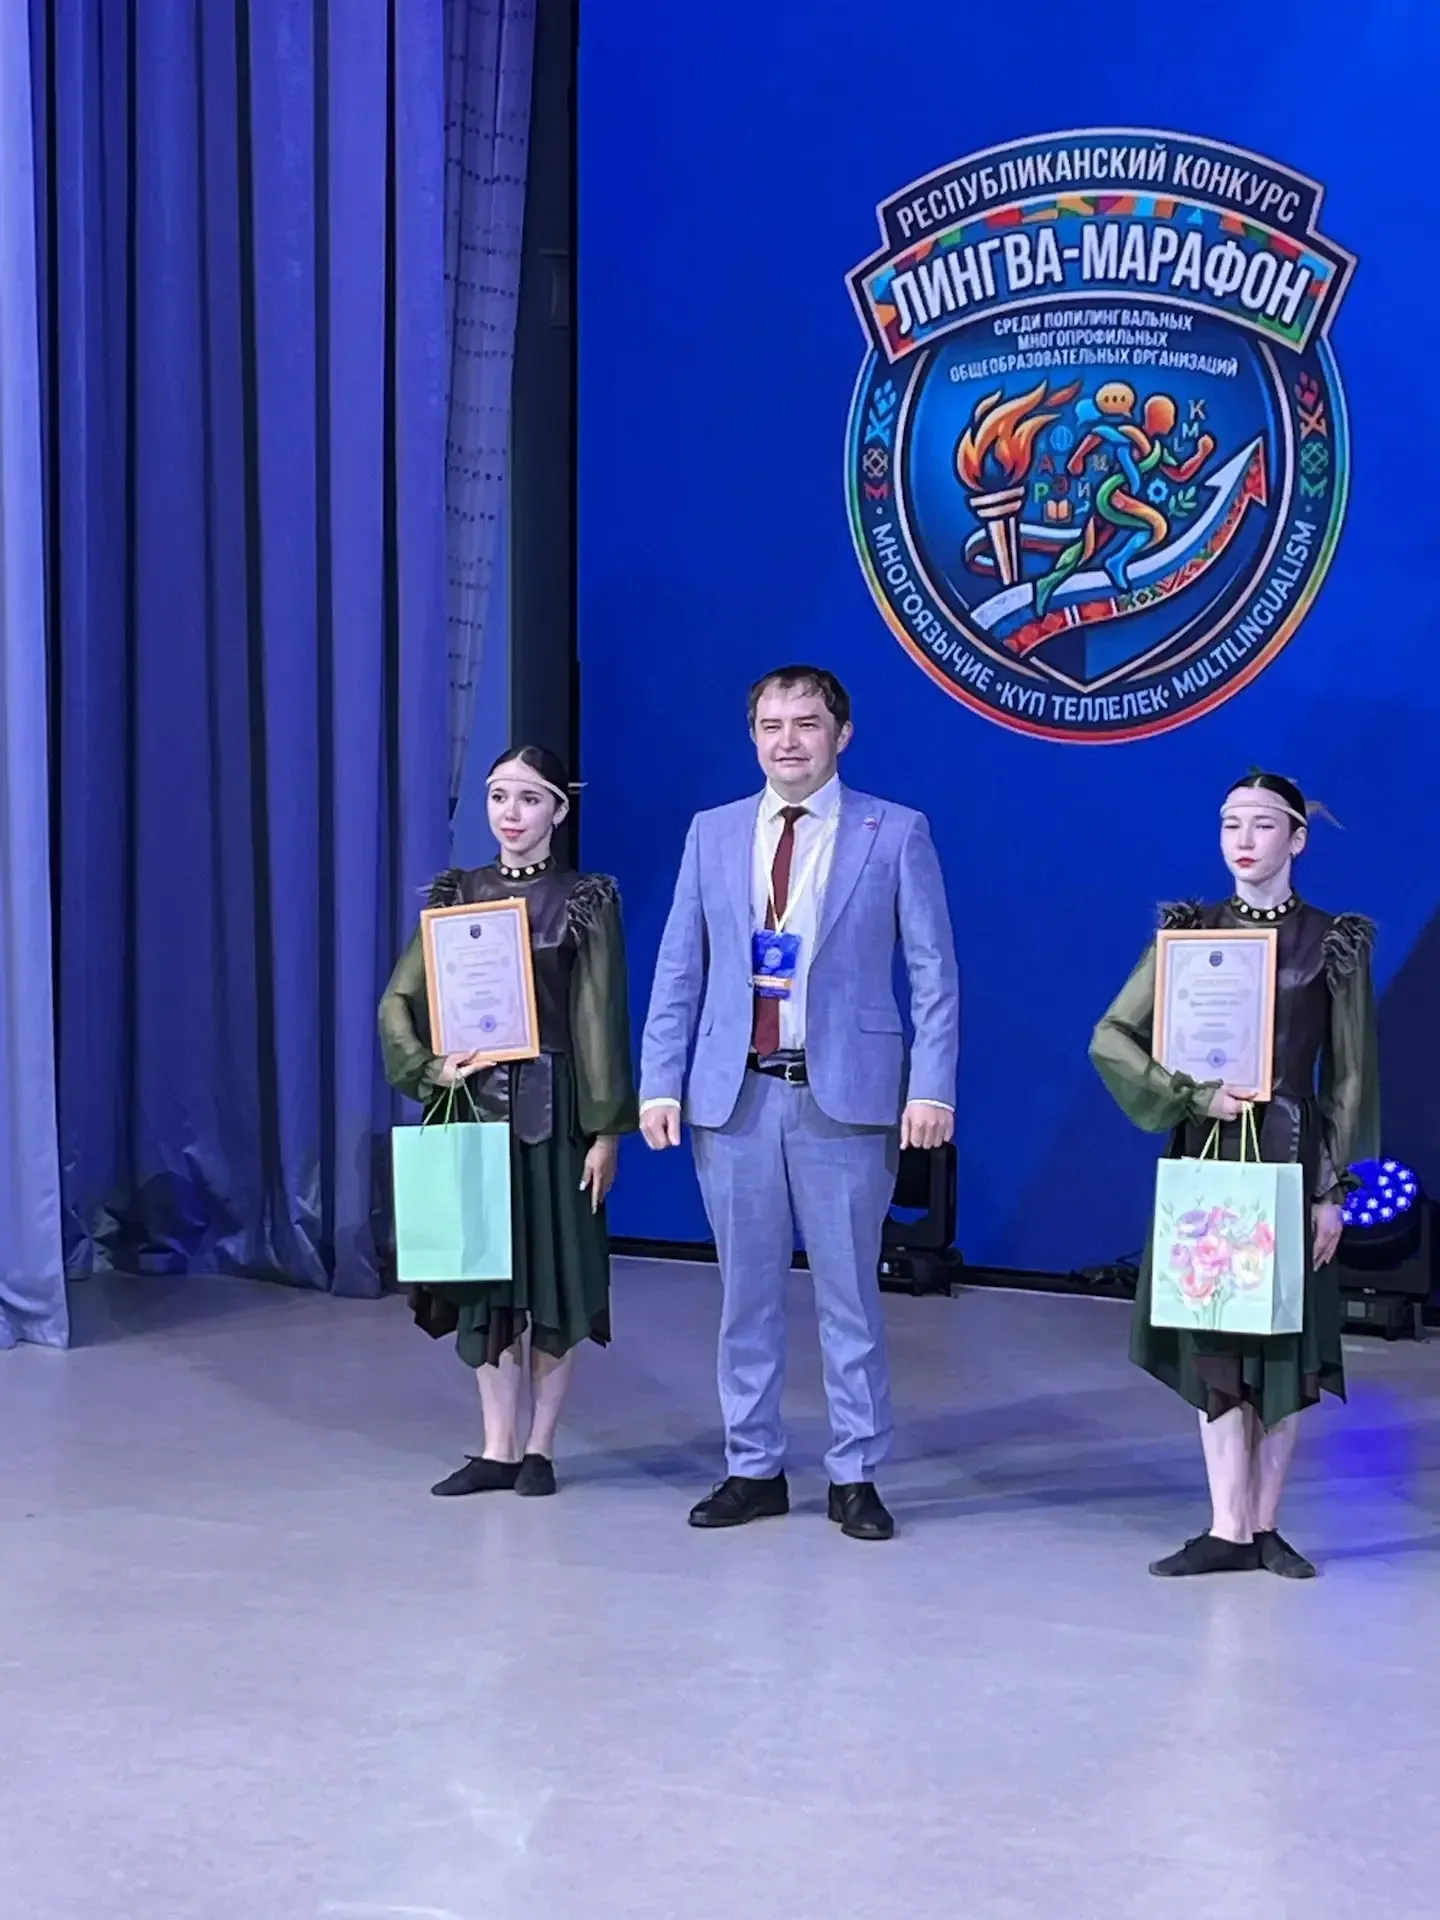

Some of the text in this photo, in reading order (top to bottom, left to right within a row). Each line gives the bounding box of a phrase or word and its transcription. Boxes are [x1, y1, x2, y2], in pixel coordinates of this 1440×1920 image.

[896, 143, 1301, 238] РЕСПУБЛИКАНСКИЙ КОНКУРС
[890, 223, 1310, 335] ЛИНГВА-МАРАФОН
[993, 312, 1041, 336] СРЕДИ
[950, 348, 1239, 383] ОБЩЕОБРАЗОВАТЕЛЬНЫХ ОРГАНИЗАЦИЙ
[1018, 328, 1168, 350] МНОГОПРОФИЛЬНЫХ
[872, 522, 995, 693] МНОГОЯЗЫЧИЕ
[1171, 519, 1317, 700] MULTILINGUALISM
